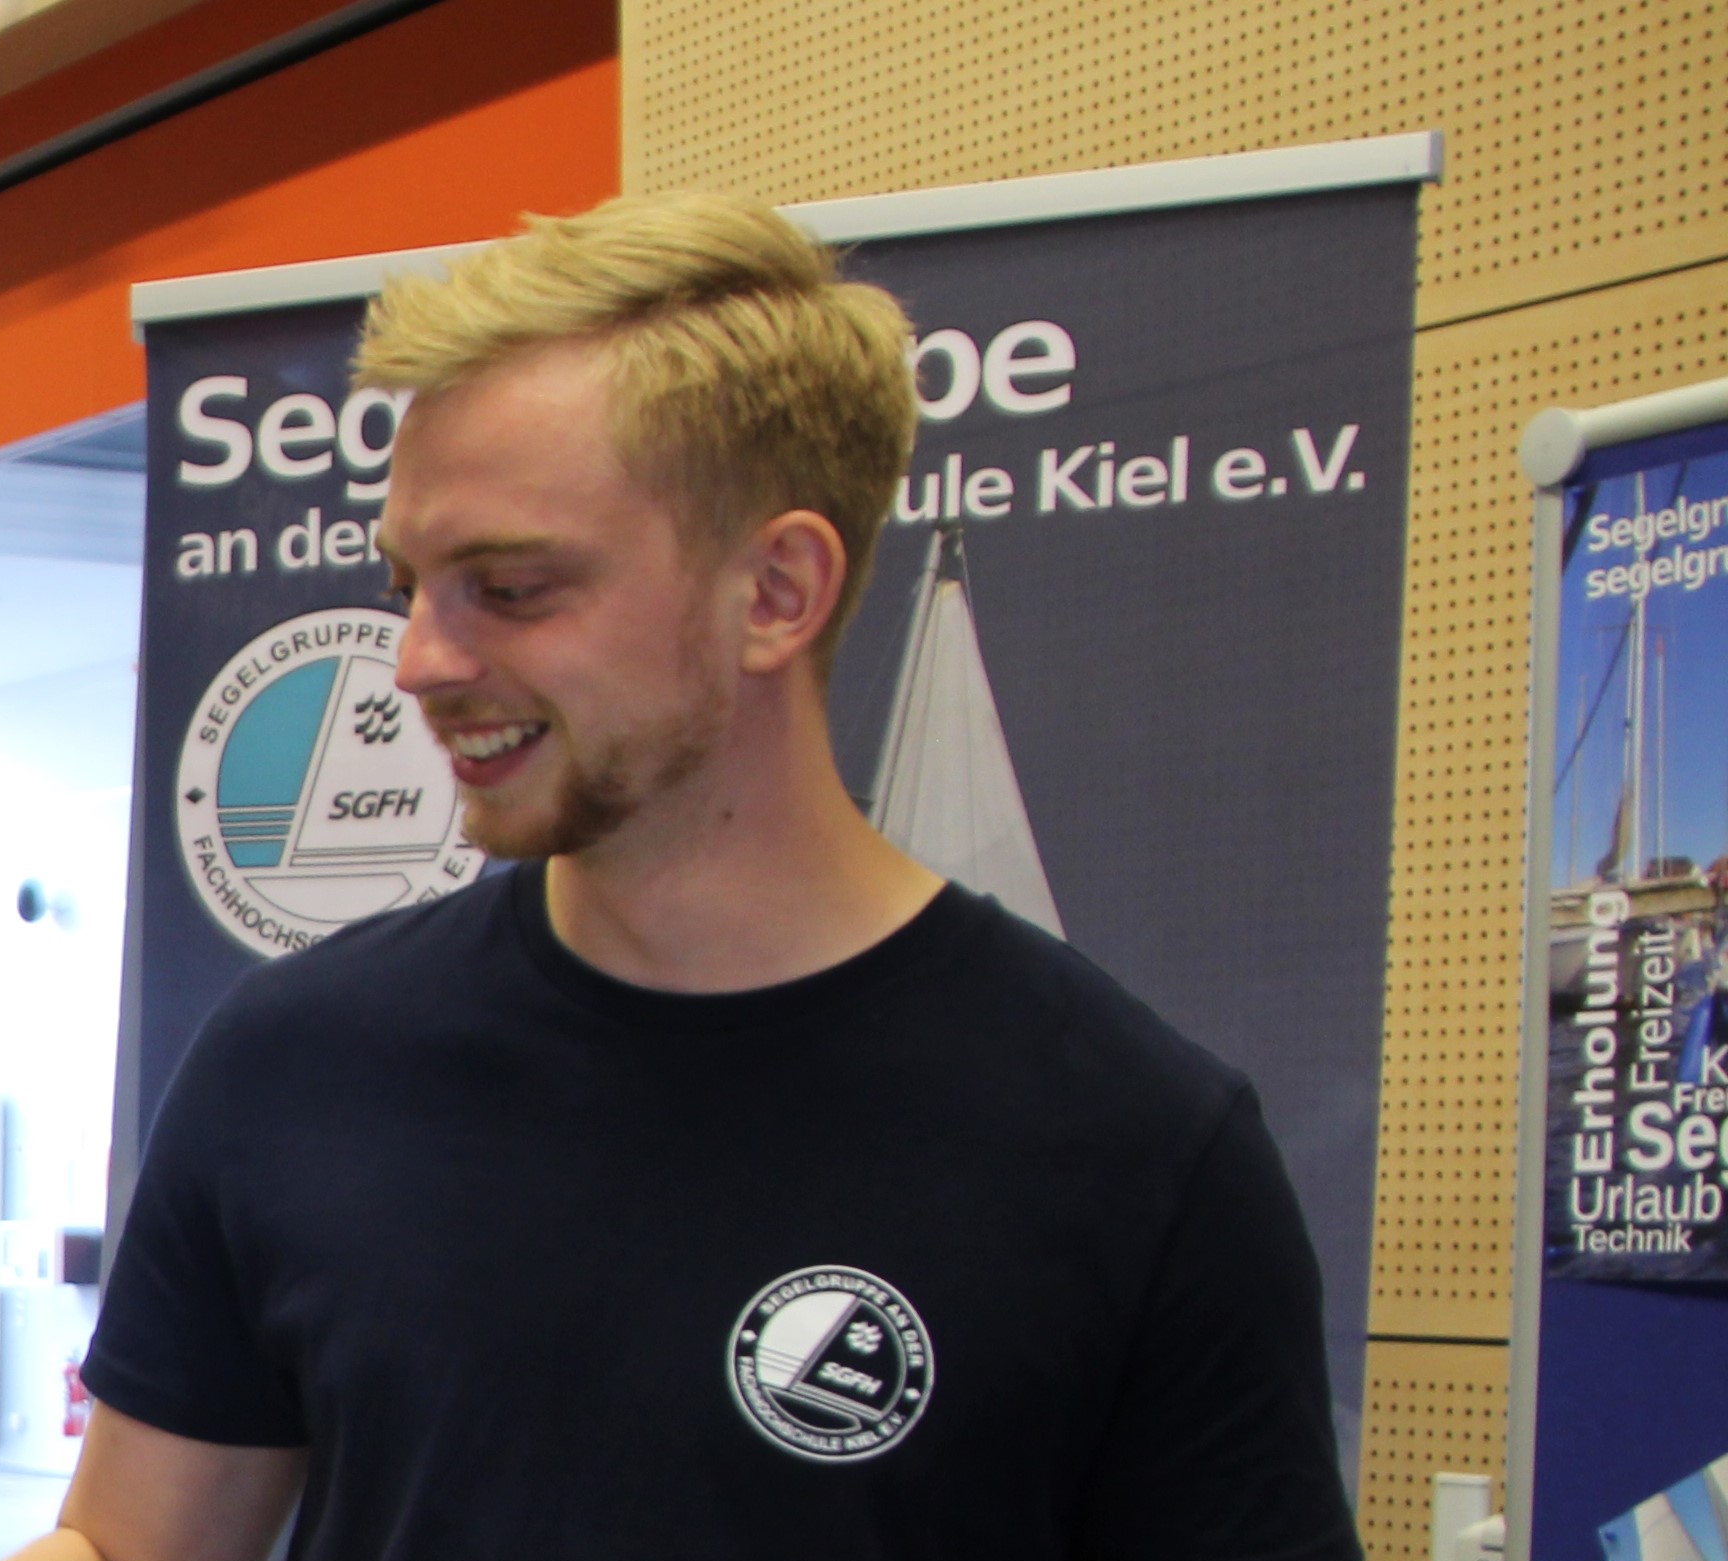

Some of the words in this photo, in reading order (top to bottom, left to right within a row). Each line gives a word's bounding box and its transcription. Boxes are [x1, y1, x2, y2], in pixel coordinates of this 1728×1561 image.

[177, 528, 259, 576] an
[1040, 436, 1189, 511] Kiel
[1215, 425, 1366, 500] e.V.
[200, 623, 393, 745] SEGELGRUPPE
[328, 787, 424, 821] SGFH
[1573, 889, 1631, 1174] Erholung
[1630, 926, 1676, 1093] Freizeit
[1571, 1172, 1723, 1222] Urlaub
[1572, 1222, 1693, 1252] Technik
[758, 1273, 890, 1316] SEGELGRUPPE
[885, 1303, 911, 1329] AN
[901, 1328, 925, 1369] DER
[816, 1361, 883, 1397] SGFH
